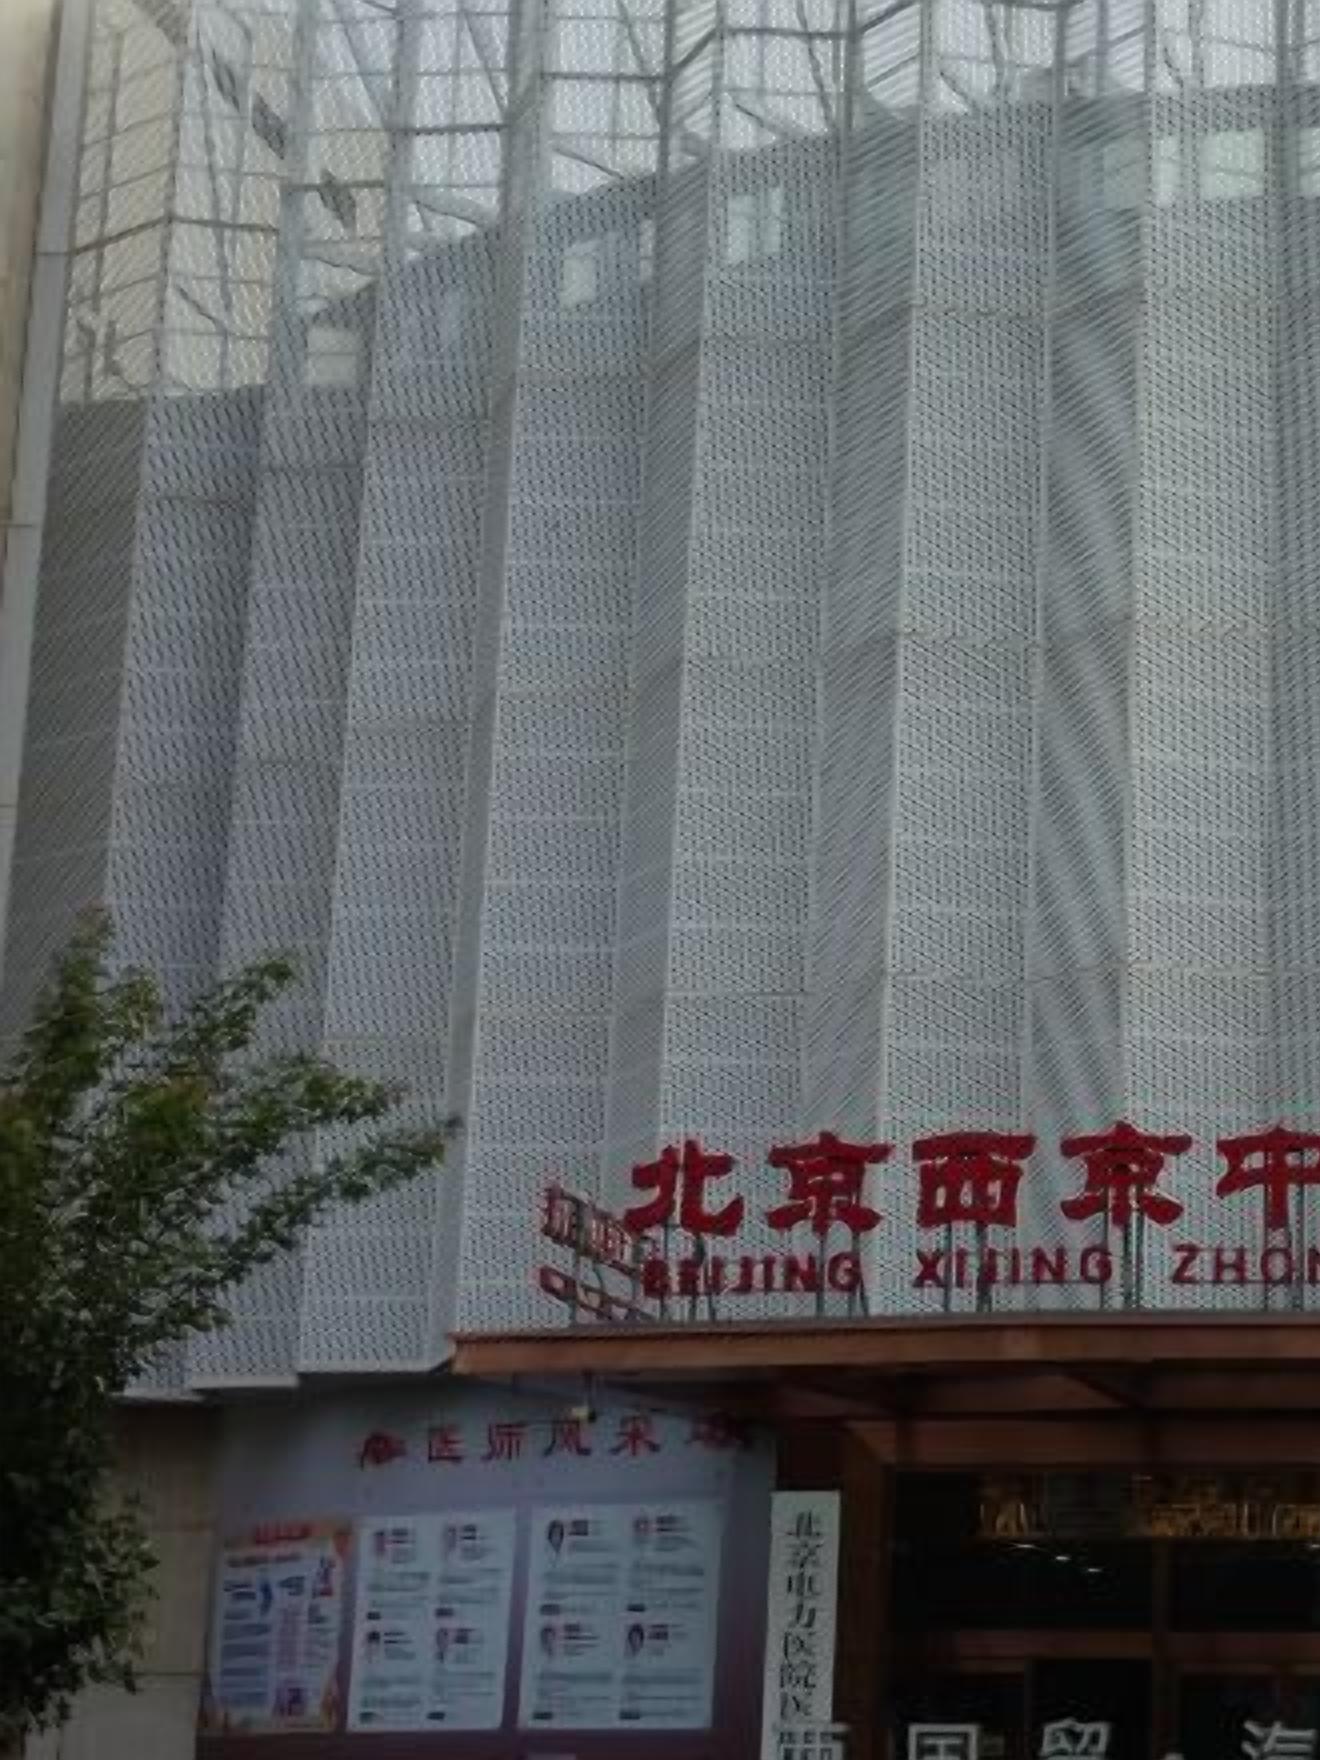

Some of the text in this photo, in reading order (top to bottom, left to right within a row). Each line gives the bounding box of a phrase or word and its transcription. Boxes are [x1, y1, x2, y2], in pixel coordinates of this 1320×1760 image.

[642, 1252, 862, 1297] BEIJING
[914, 1246, 1113, 1289] XIJING
[427, 1416, 660, 1464] 医师风采
